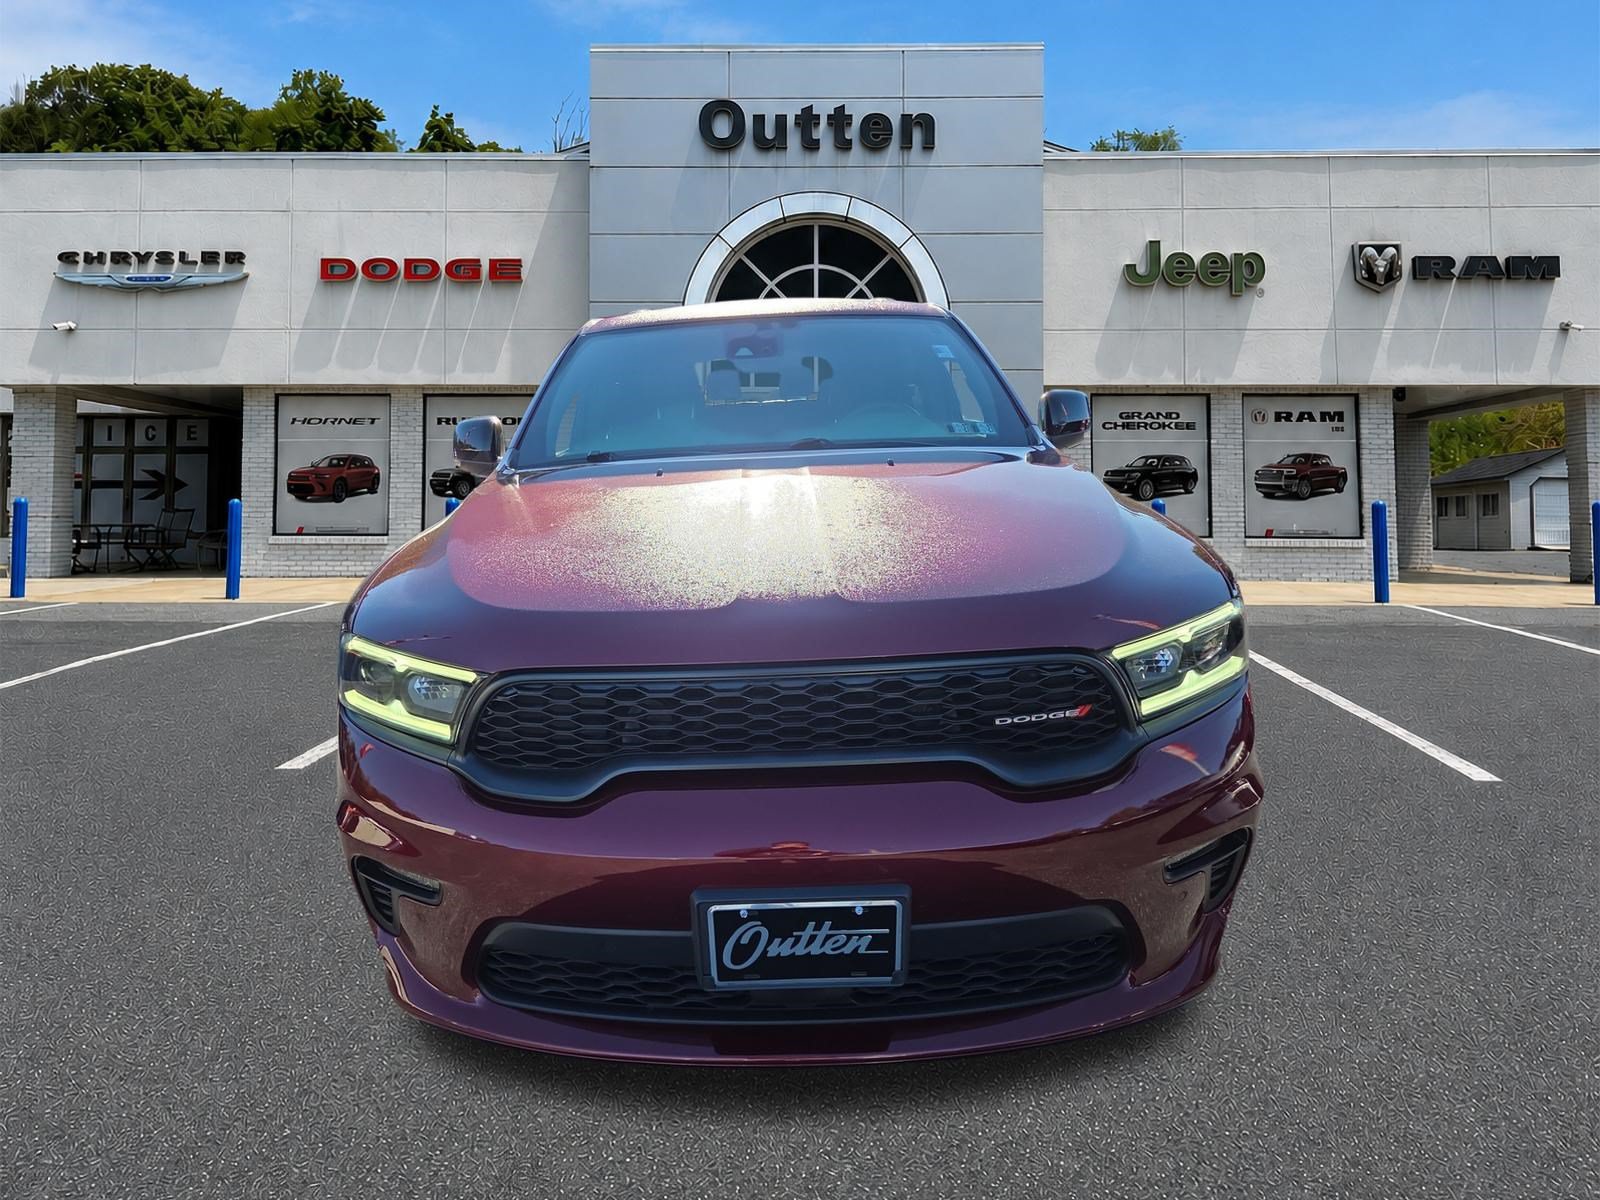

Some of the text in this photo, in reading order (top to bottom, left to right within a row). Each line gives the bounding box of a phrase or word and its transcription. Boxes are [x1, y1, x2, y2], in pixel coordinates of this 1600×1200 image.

[699, 99, 935, 150] Outten
[57, 251, 246, 265] CHRYSLER
[319, 258, 523, 283] DODGE
[1123, 240, 1266, 296] Jeep
[1411, 255, 1561, 280] RAM
[290, 417, 380, 425] HORNET
[1118, 411, 1180, 420] GRAND
[1274, 411, 1344, 422] RAM
[1101, 421, 1196, 430] CHEROKEE
[995, 709, 1081, 725] DODGE
[722, 921, 889, 970] Outten
